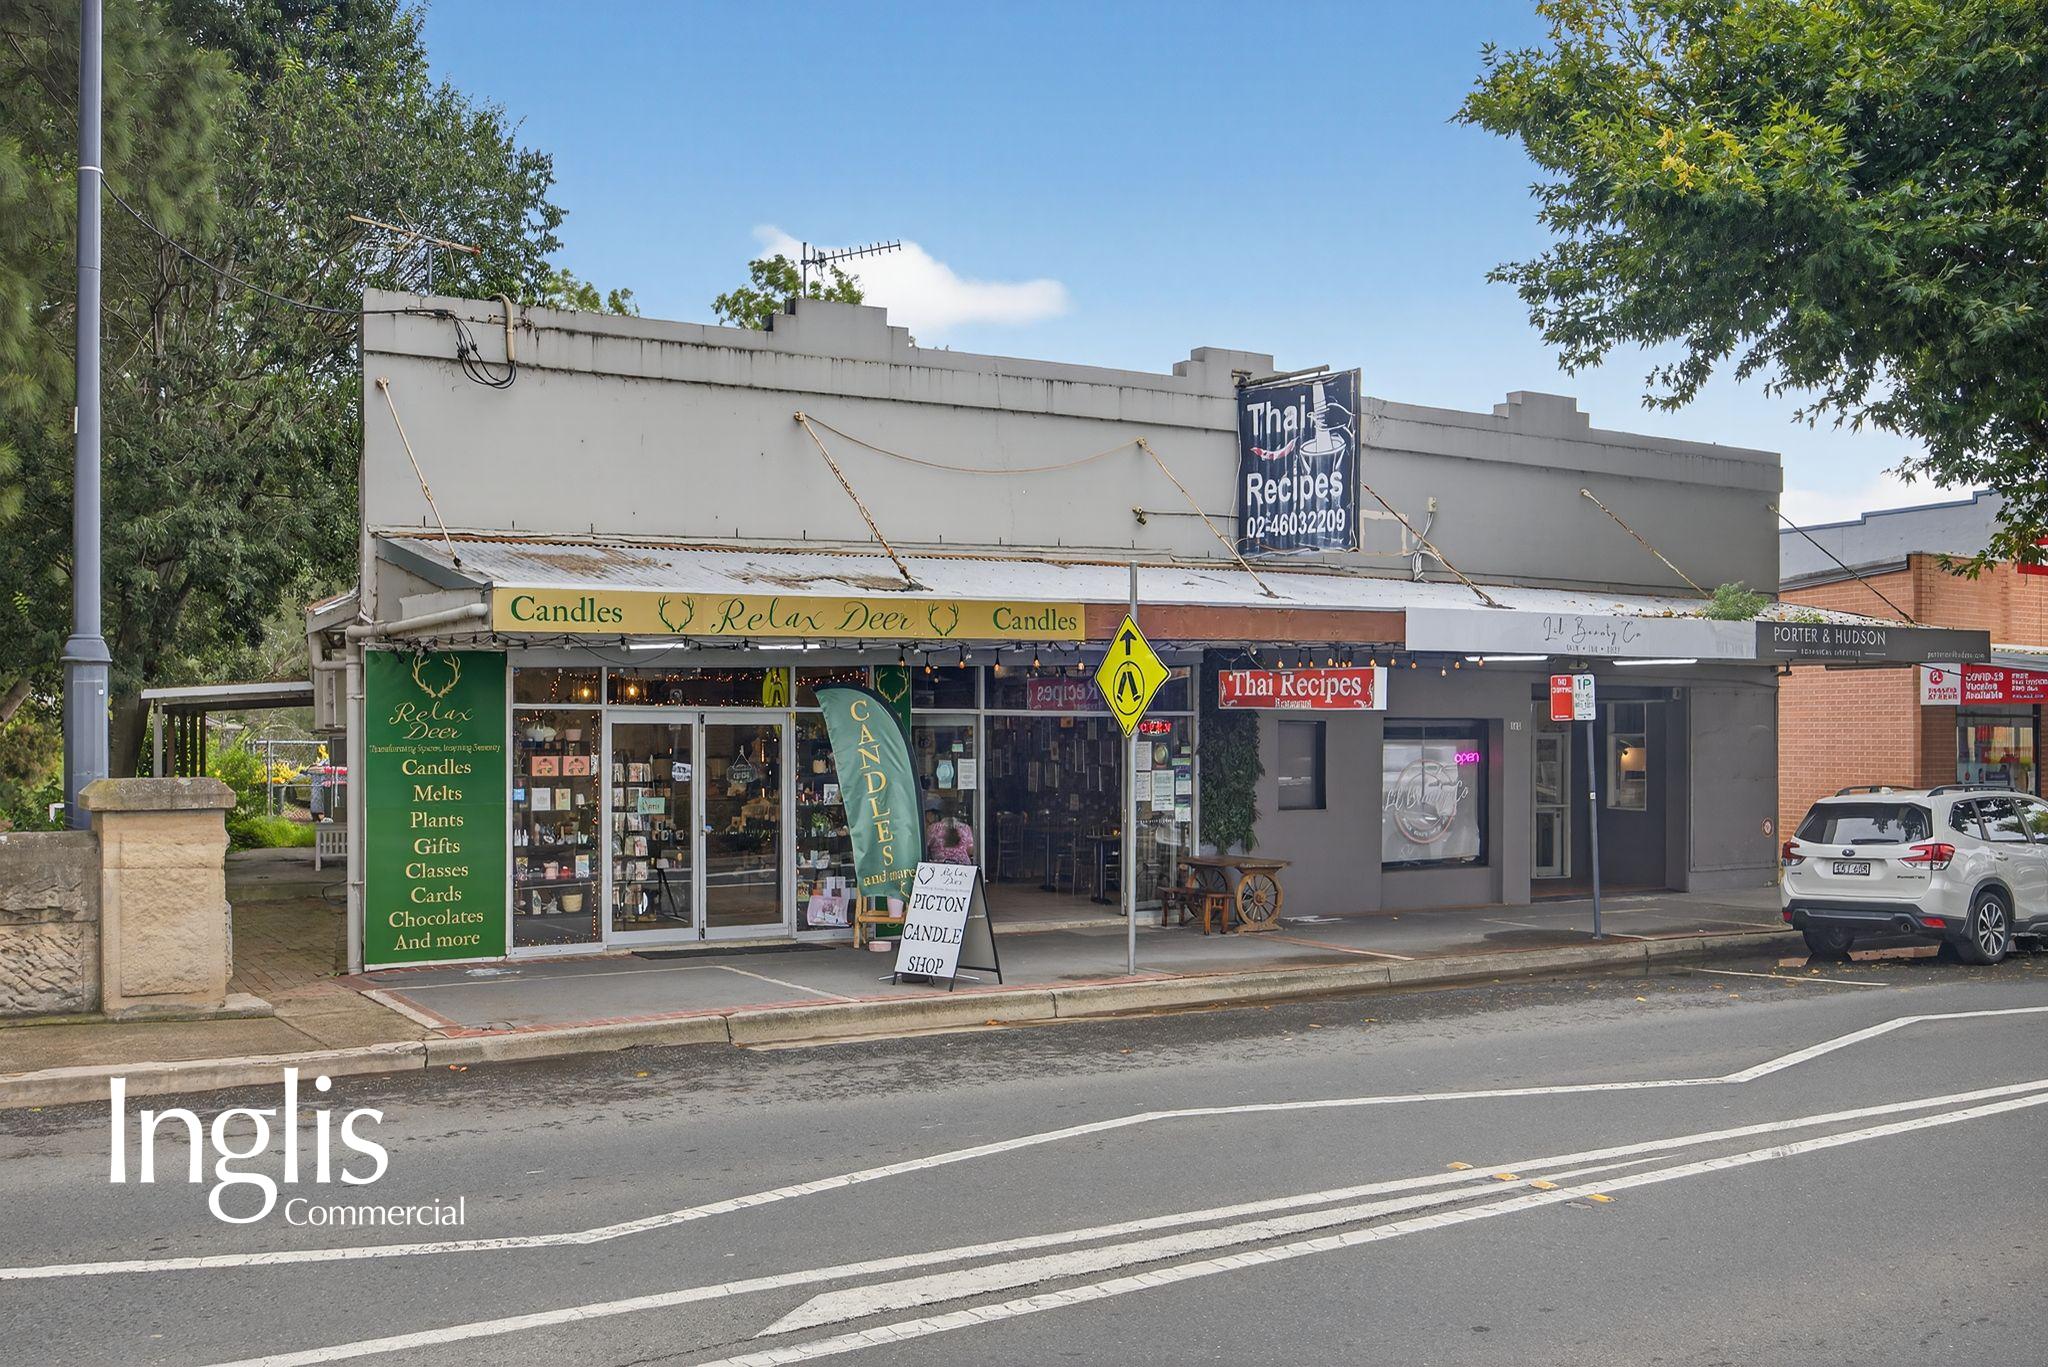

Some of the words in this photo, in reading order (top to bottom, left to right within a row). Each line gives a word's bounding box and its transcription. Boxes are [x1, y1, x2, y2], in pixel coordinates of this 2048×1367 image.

[1247, 395, 1306, 436] Thai
[1247, 471, 1344, 509] Recipes
[1247, 509, 1346, 539] 02-46032209
[510, 595, 623, 623] Candles
[710, 597, 827, 634] Relax
[834, 600, 916, 633] Deer
[992, 607, 1077, 632] Candles
[1773, 626, 1819, 644] PORTER
[1822, 628, 1831, 644] &
[1835, 629, 1886, 646] HUDSON
[1232, 671, 1274, 697] Thai
[1279, 670, 1362, 703] Recipes
[1577, 679, 1592, 690] 1P
[388, 701, 474, 725] Relax
[402, 721, 463, 740] Deer
[401, 758, 472, 776] Candles
[1454, 752, 1480, 765] open
[413, 784, 463, 802] Melts
[850, 699, 895, 867] CANDLES
[410, 811, 464, 829] Plants
[413, 837, 461, 855] Gifts
[405, 862, 469, 879] Classes
[863, 869, 887, 888] and
[889, 866, 917, 883] more
[410, 885, 462, 904] Cards
[912, 893, 967, 913] PICTON
[388, 908, 484, 928] Chocolates
[394, 932, 431, 951] And
[437, 933, 481, 948] more
[903, 922, 963, 945] CANDLE
[907, 955, 944, 975] SHOP
